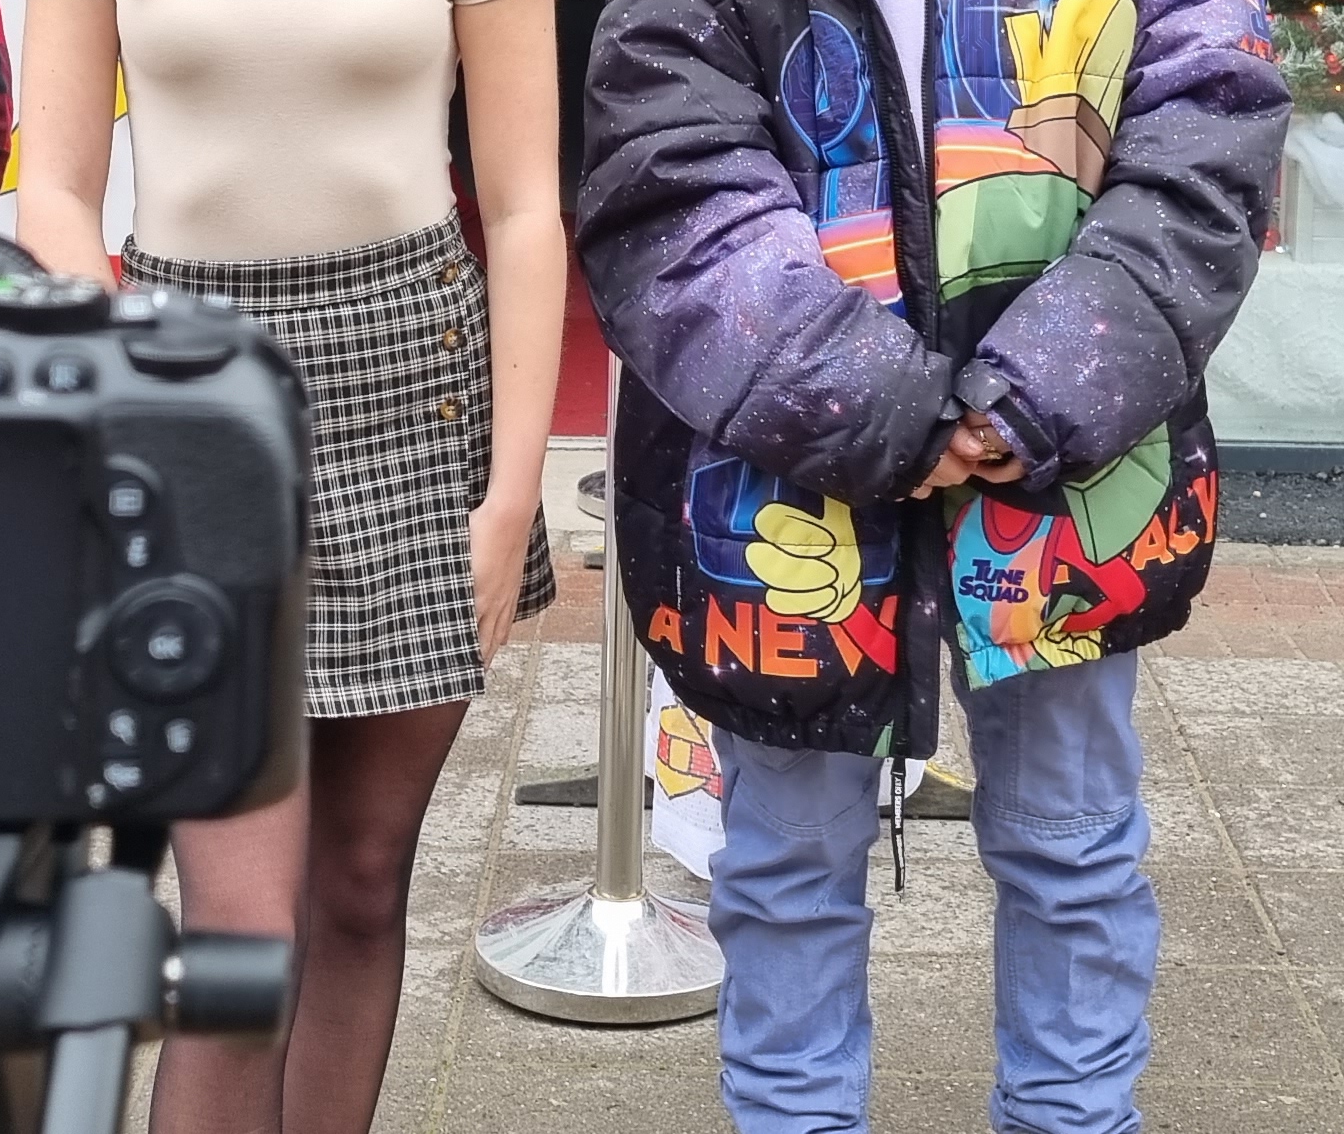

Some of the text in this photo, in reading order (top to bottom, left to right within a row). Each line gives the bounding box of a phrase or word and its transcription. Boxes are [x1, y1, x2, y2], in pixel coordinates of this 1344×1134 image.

[972, 559, 1025, 586] TUNE
[958, 575, 1029, 604] SQUAD
[647, 602, 684, 655] A
